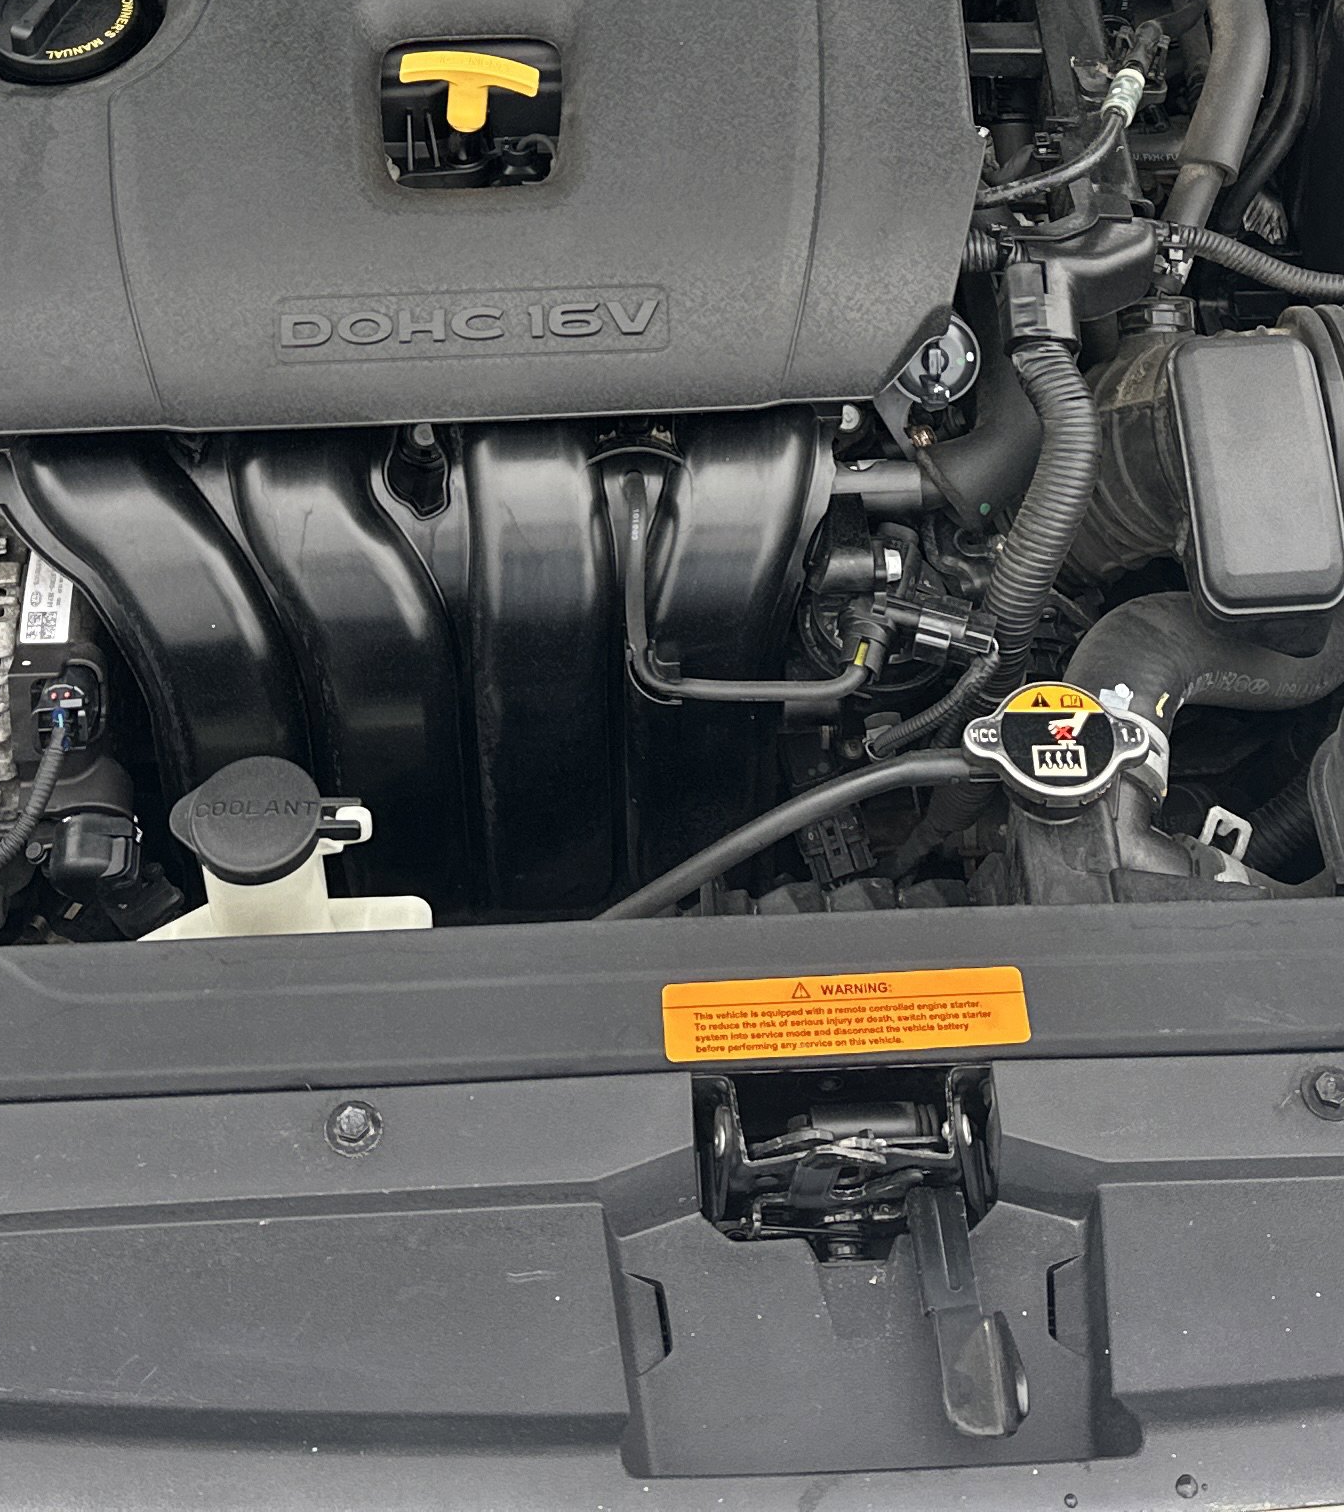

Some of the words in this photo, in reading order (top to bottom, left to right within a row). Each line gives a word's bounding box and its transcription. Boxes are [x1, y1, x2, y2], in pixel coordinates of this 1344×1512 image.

[45, 37, 104, 60] MANUAL
[280, 306, 505, 348] DOHC
[527, 300, 659, 340] 16V
[969, 728, 999, 743] HCC
[1121, 727, 1141, 743] 1.1
[195, 799, 319, 818] COOLANT
[820, 982, 893, 996] WARNING:
[694, 1012, 714, 1021] This
[716, 1011, 748, 1020] vehicle
[750, 1010, 759, 1018] is
[761, 1008, 803, 1020] equipped
[805, 1006, 825, 1015] with
[834, 1005, 867, 1014] remote
[869, 1002, 914, 1013] controlled
[917, 1001, 947, 1011] engine
[694, 1023, 706, 1031] To
[709, 1021, 739, 1030] reduce
[742, 1020, 757, 1028] the
[760, 1019, 776, 1028] risk
[779, 1019, 788, 1027] of
[791, 1018, 824, 1027] serious
[827, 1016, 852, 1027] injury
[866, 1015, 895, 1024] death,
[897, 1012, 926, 1022] switch
[929, 1011, 960, 1022] engine
[962, 1010, 991, 1019] starter
[695, 1034, 728, 1043] system
[731, 1032, 748, 1040] into
[751, 1030, 783, 1040] service
[786, 1029, 811, 1038] mode
[814, 1028, 831, 1036] and
[834, 1026, 883, 1036] disconnect
[886, 1024, 901, 1033] the
[902, 1023, 935, 1032] vehicle
[937, 1022, 969, 1032] battery
[696, 1044, 725, 1053] before
[728, 1042, 778, 1053] performing
[781, 1041, 797, 1051] any
[800, 1040, 832, 1049] service
[849, 1037, 866, 1046] this
[869, 1036, 904, 1045] vehicle.
